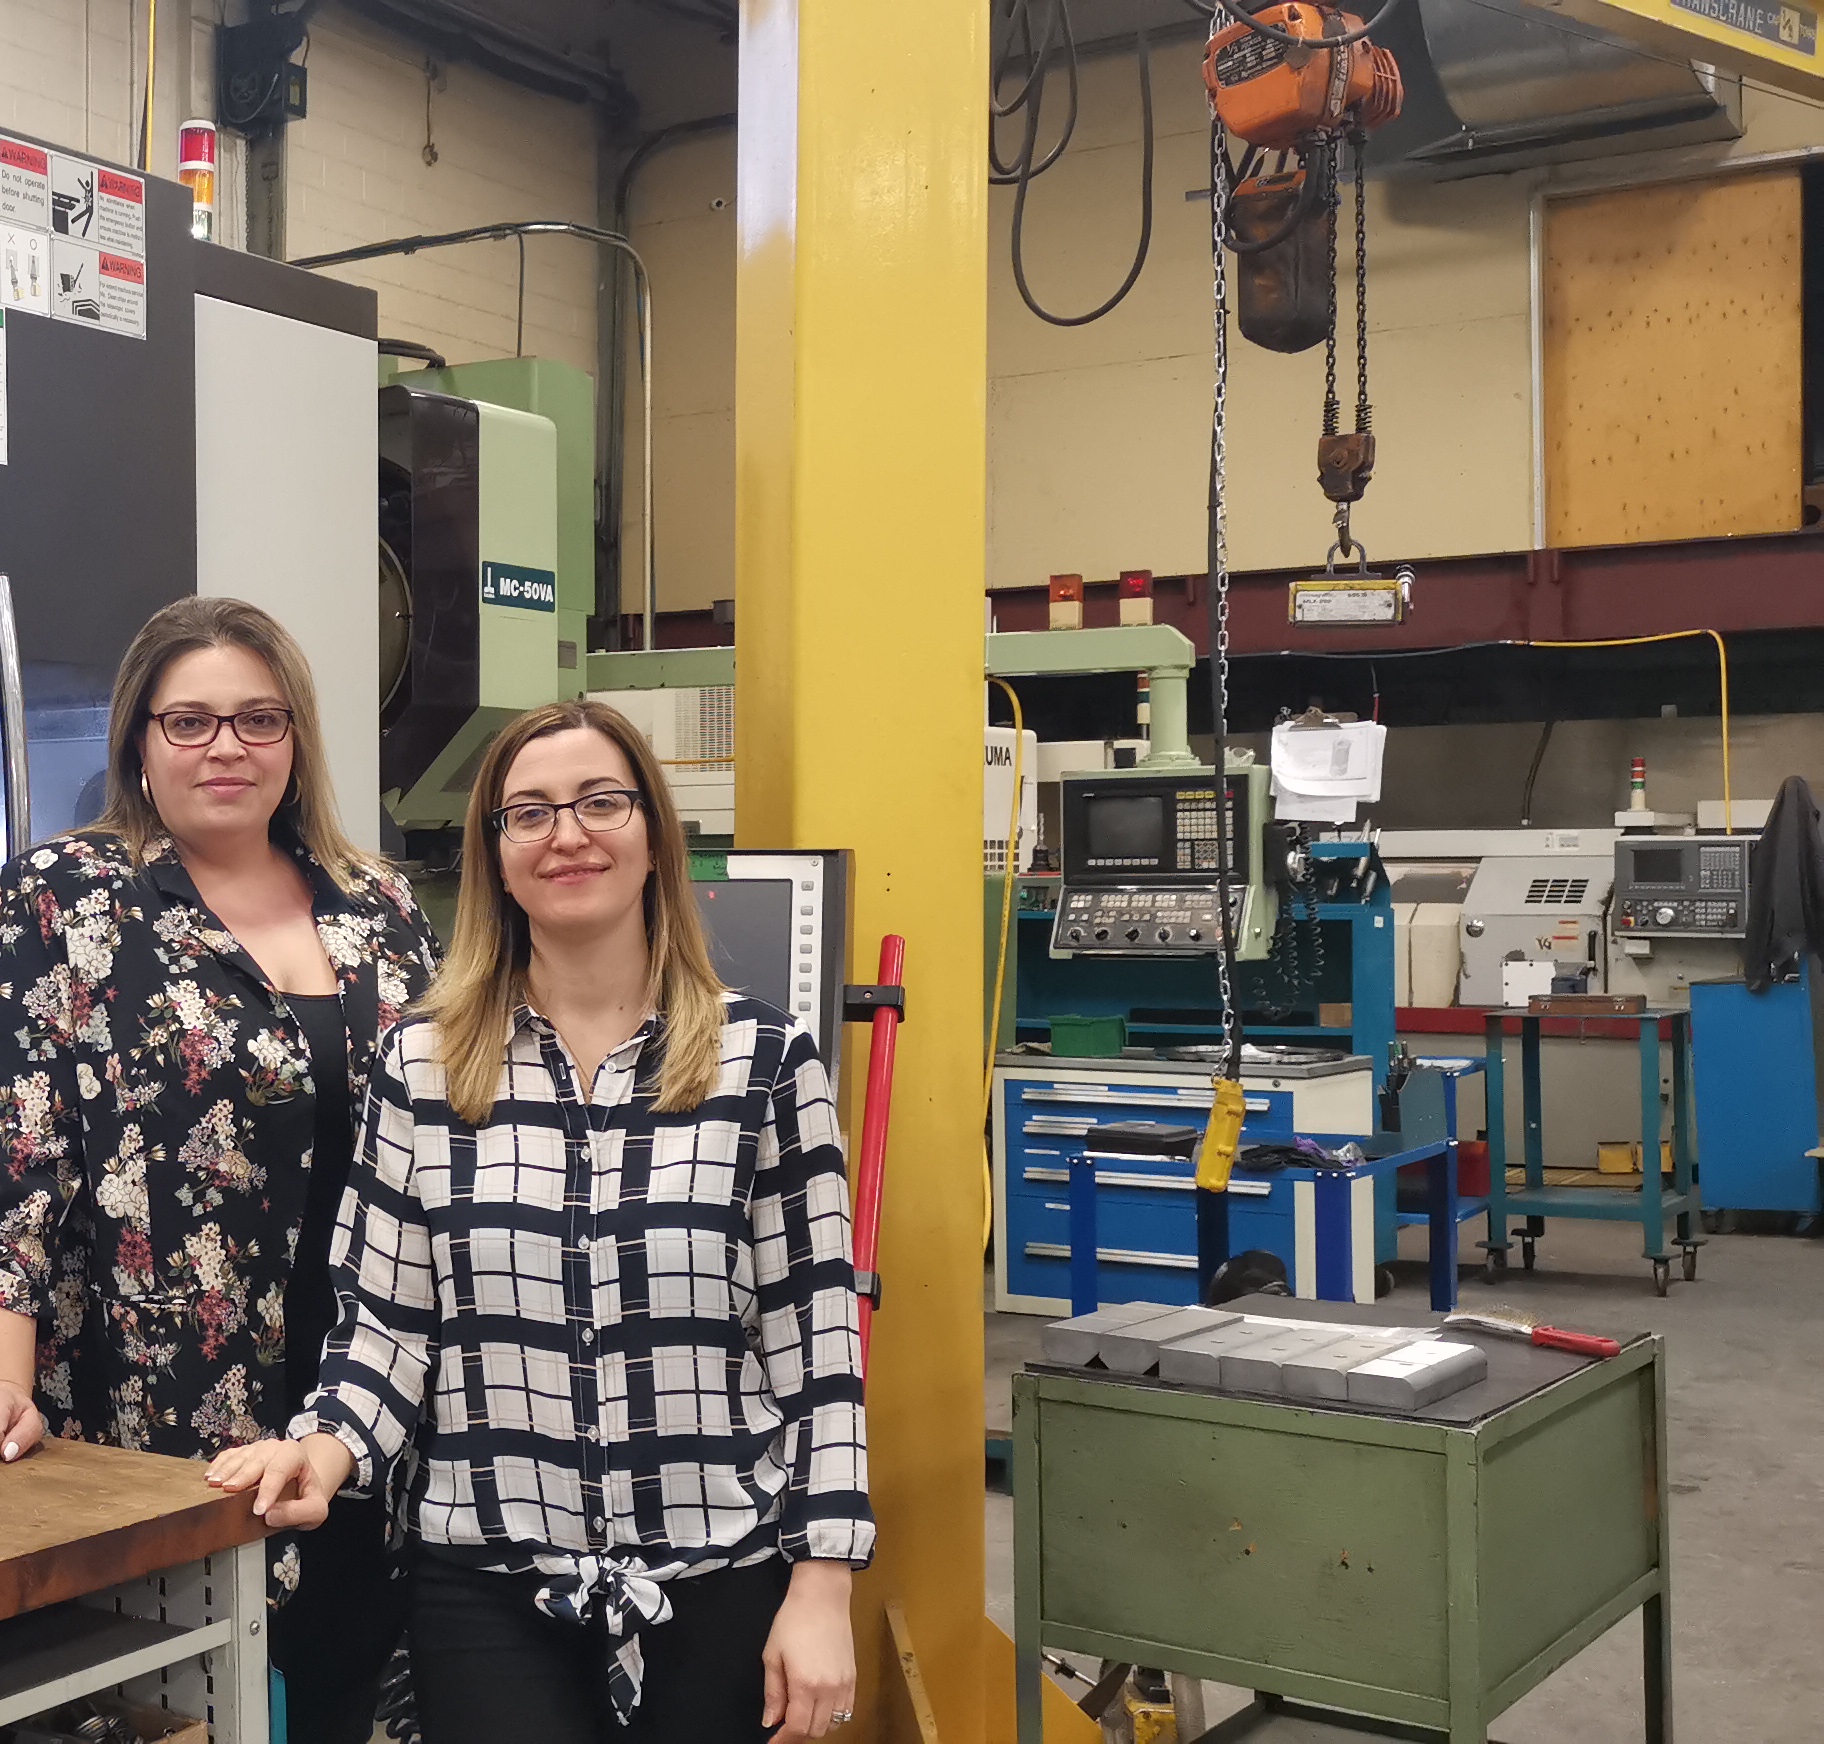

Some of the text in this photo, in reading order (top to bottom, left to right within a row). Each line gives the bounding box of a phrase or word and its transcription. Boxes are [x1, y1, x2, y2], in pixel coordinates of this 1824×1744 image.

[1673, 0, 1764, 34] NSCRANE
[1, 169, 46, 191] Do not operate
[1, 185, 45, 208] before shutting
[500, 577, 554, 603] MC-50VA
[984, 746, 1012, 767] UMA
